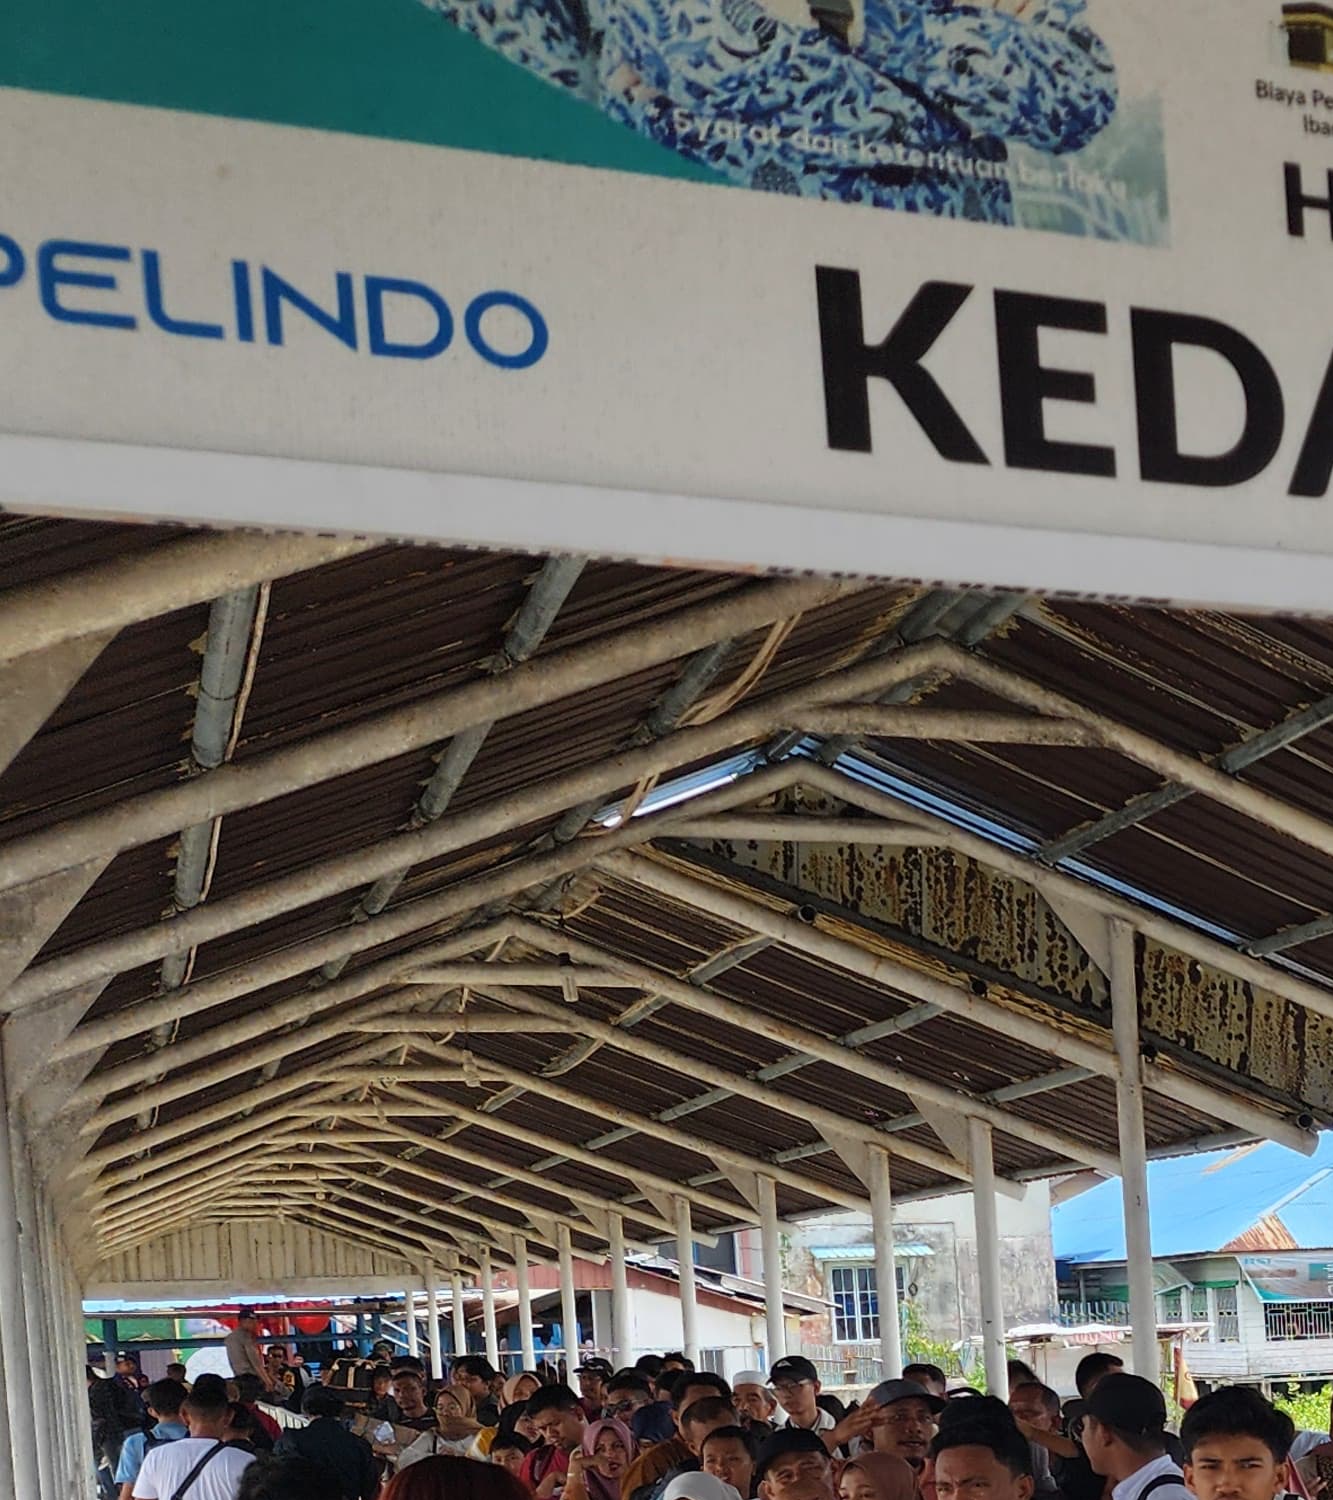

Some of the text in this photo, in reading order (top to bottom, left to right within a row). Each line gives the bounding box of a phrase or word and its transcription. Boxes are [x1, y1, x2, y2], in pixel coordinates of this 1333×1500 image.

[1255, 79, 1306, 107] Biaya
[673, 107, 782, 141] Syarat
[796, 126, 849, 156] dan
[858, 132, 1012, 180] ketentuan
[0, 234, 549, 369] ELINDO
